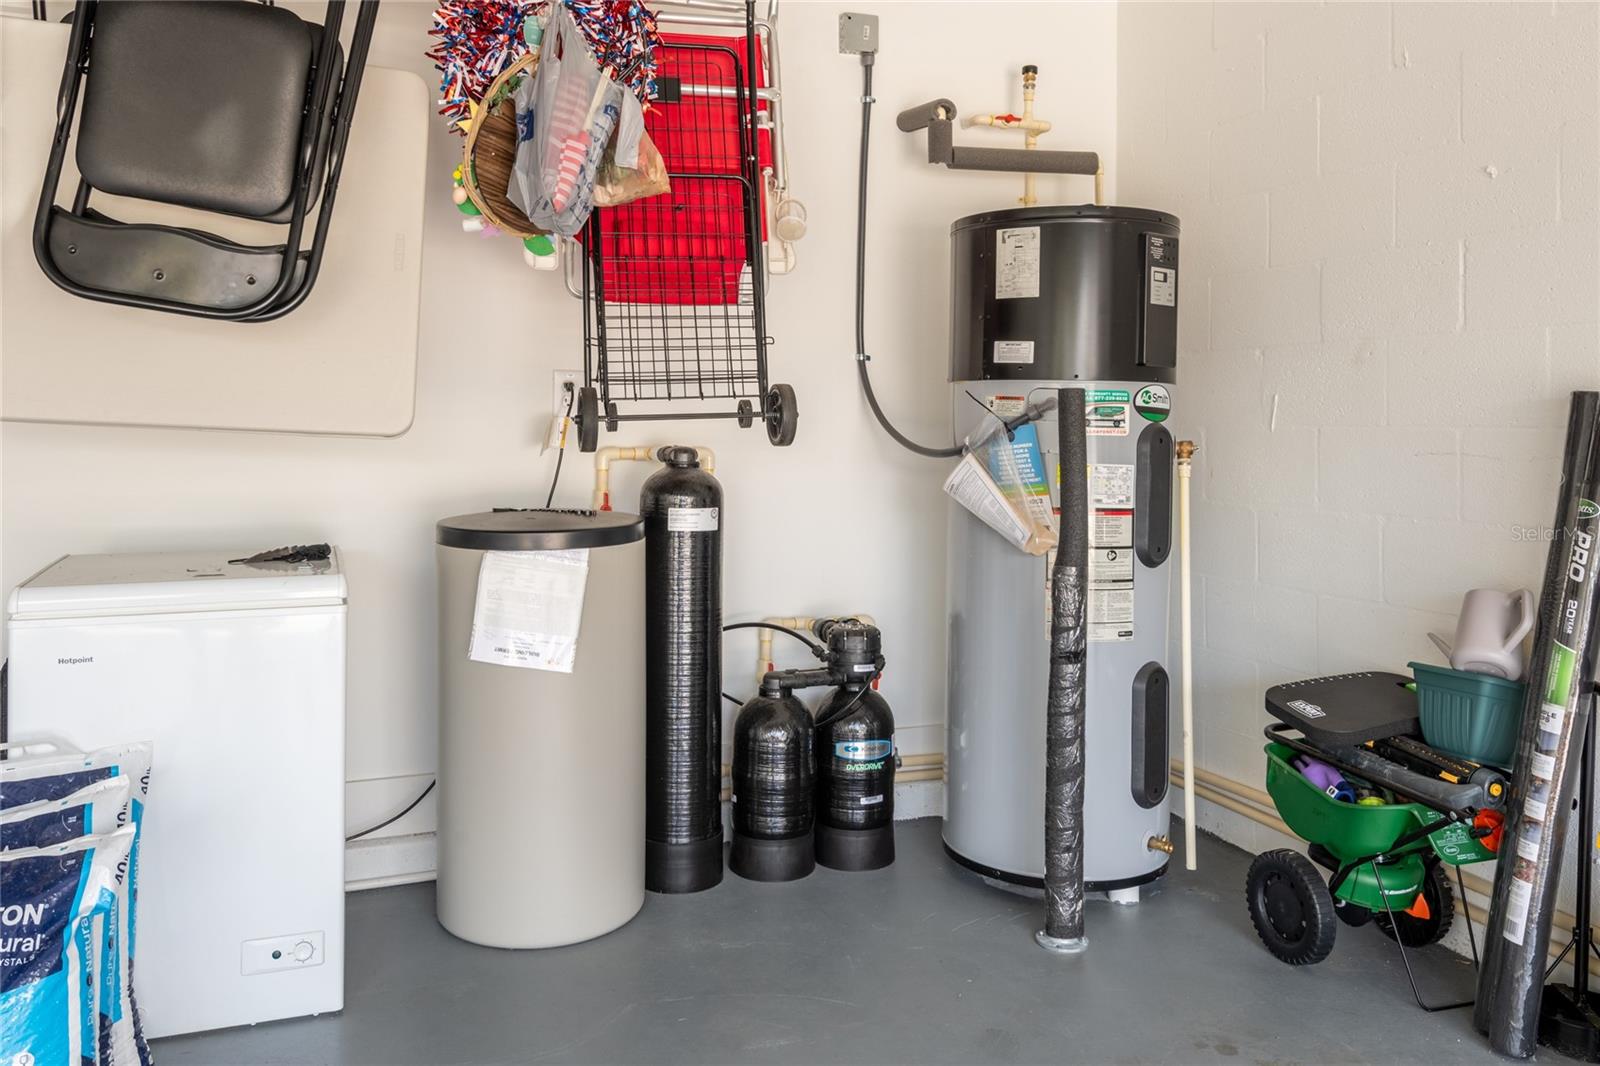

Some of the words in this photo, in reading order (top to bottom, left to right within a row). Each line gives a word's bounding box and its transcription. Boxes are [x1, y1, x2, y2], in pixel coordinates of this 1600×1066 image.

[1569, 531, 1594, 583] PRO
[57, 656, 95, 665] Hotpoint
[846, 763, 882, 771] OVERDRIVE
[80, 916, 93, 973] Natura
